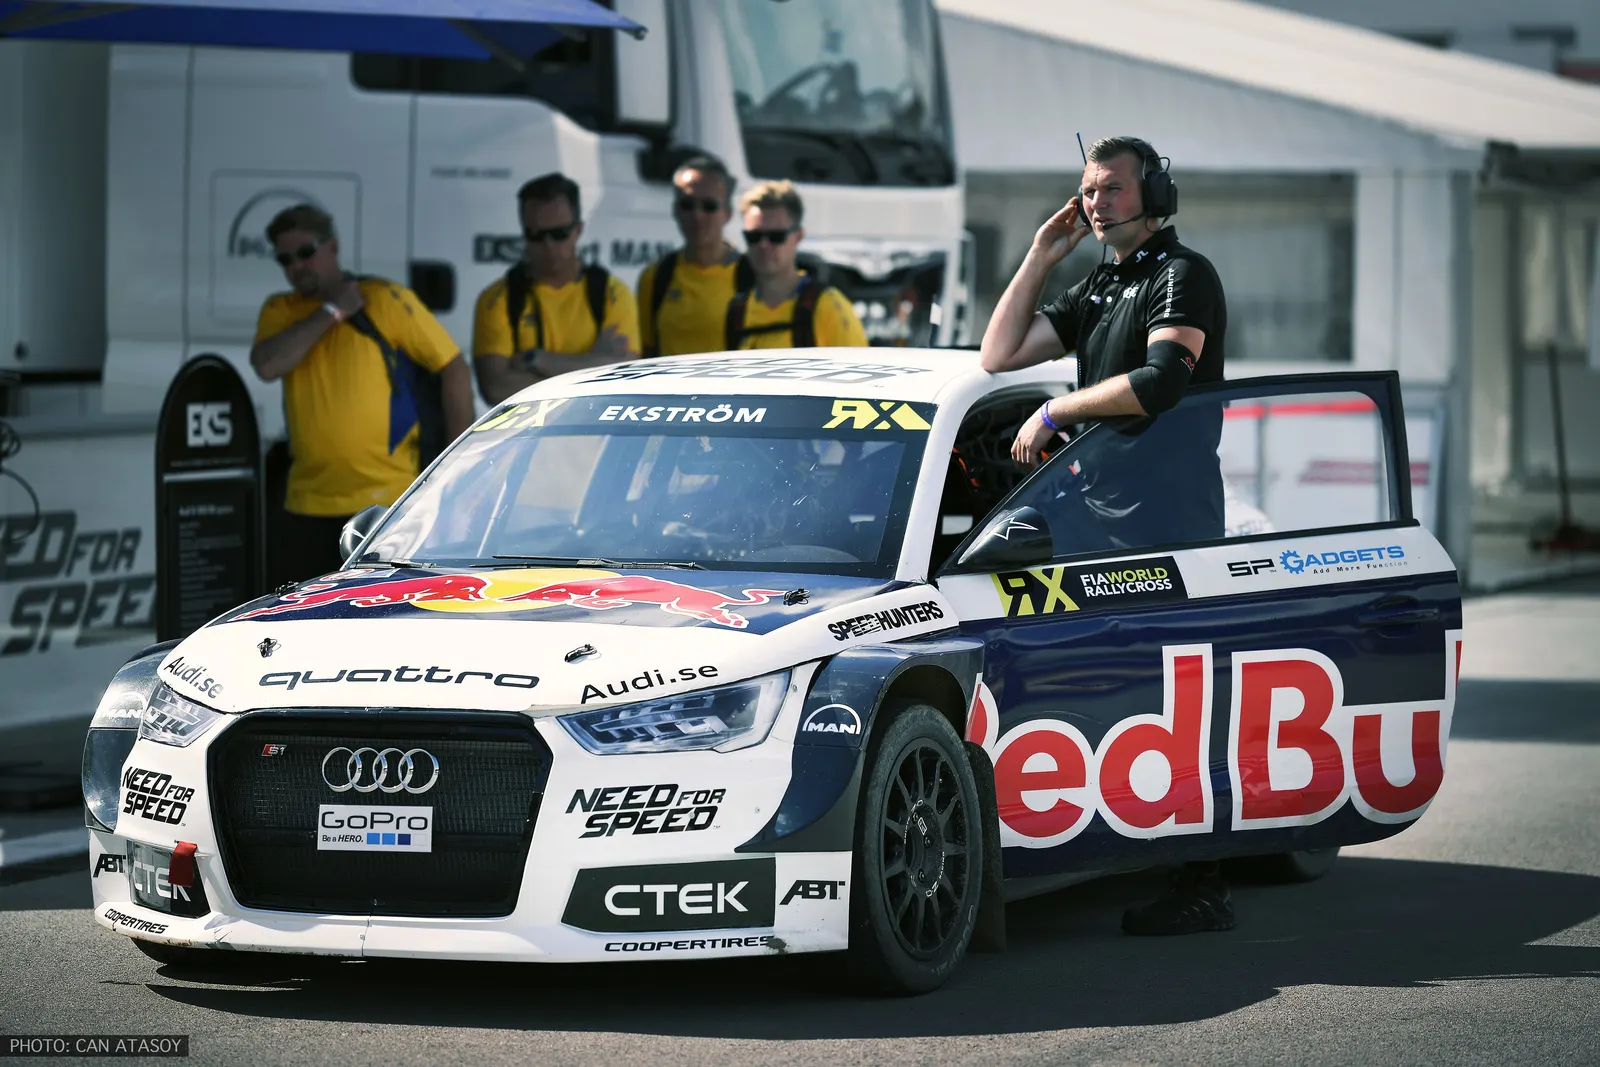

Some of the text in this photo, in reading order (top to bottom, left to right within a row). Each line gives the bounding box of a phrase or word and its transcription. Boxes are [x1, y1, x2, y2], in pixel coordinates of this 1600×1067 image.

[573, 366, 897, 385] SPEED
[597, 403, 767, 424] EKSTRÖM
[0, 510, 77, 583] ED
[65, 527, 142, 578] FOR
[1226, 545, 1405, 578] SP GADGETS
[1367, 561, 1408, 570] Function
[1084, 578, 1173, 598] RALLYCROSS
[0, 574, 157, 657] SPEE
[163, 656, 224, 699] Audi.se
[259, 665, 540, 690] quattro
[580, 665, 719, 704] Audi.se
[807, 722, 858, 735] MAN
[1228, 629, 1463, 832] Bu
[122, 766, 195, 802] NEED FOR
[565, 784, 727, 814] NEED FOR
[123, 791, 187, 825] SPEED
[321, 811, 428, 831] GoPro
[578, 806, 718, 839] SPEED
[338, 835, 364, 843] HERO.
[604, 881, 749, 916] CTEK
[779, 880, 845, 905] ABT
[104, 908, 169, 934] COOPERTIRES
